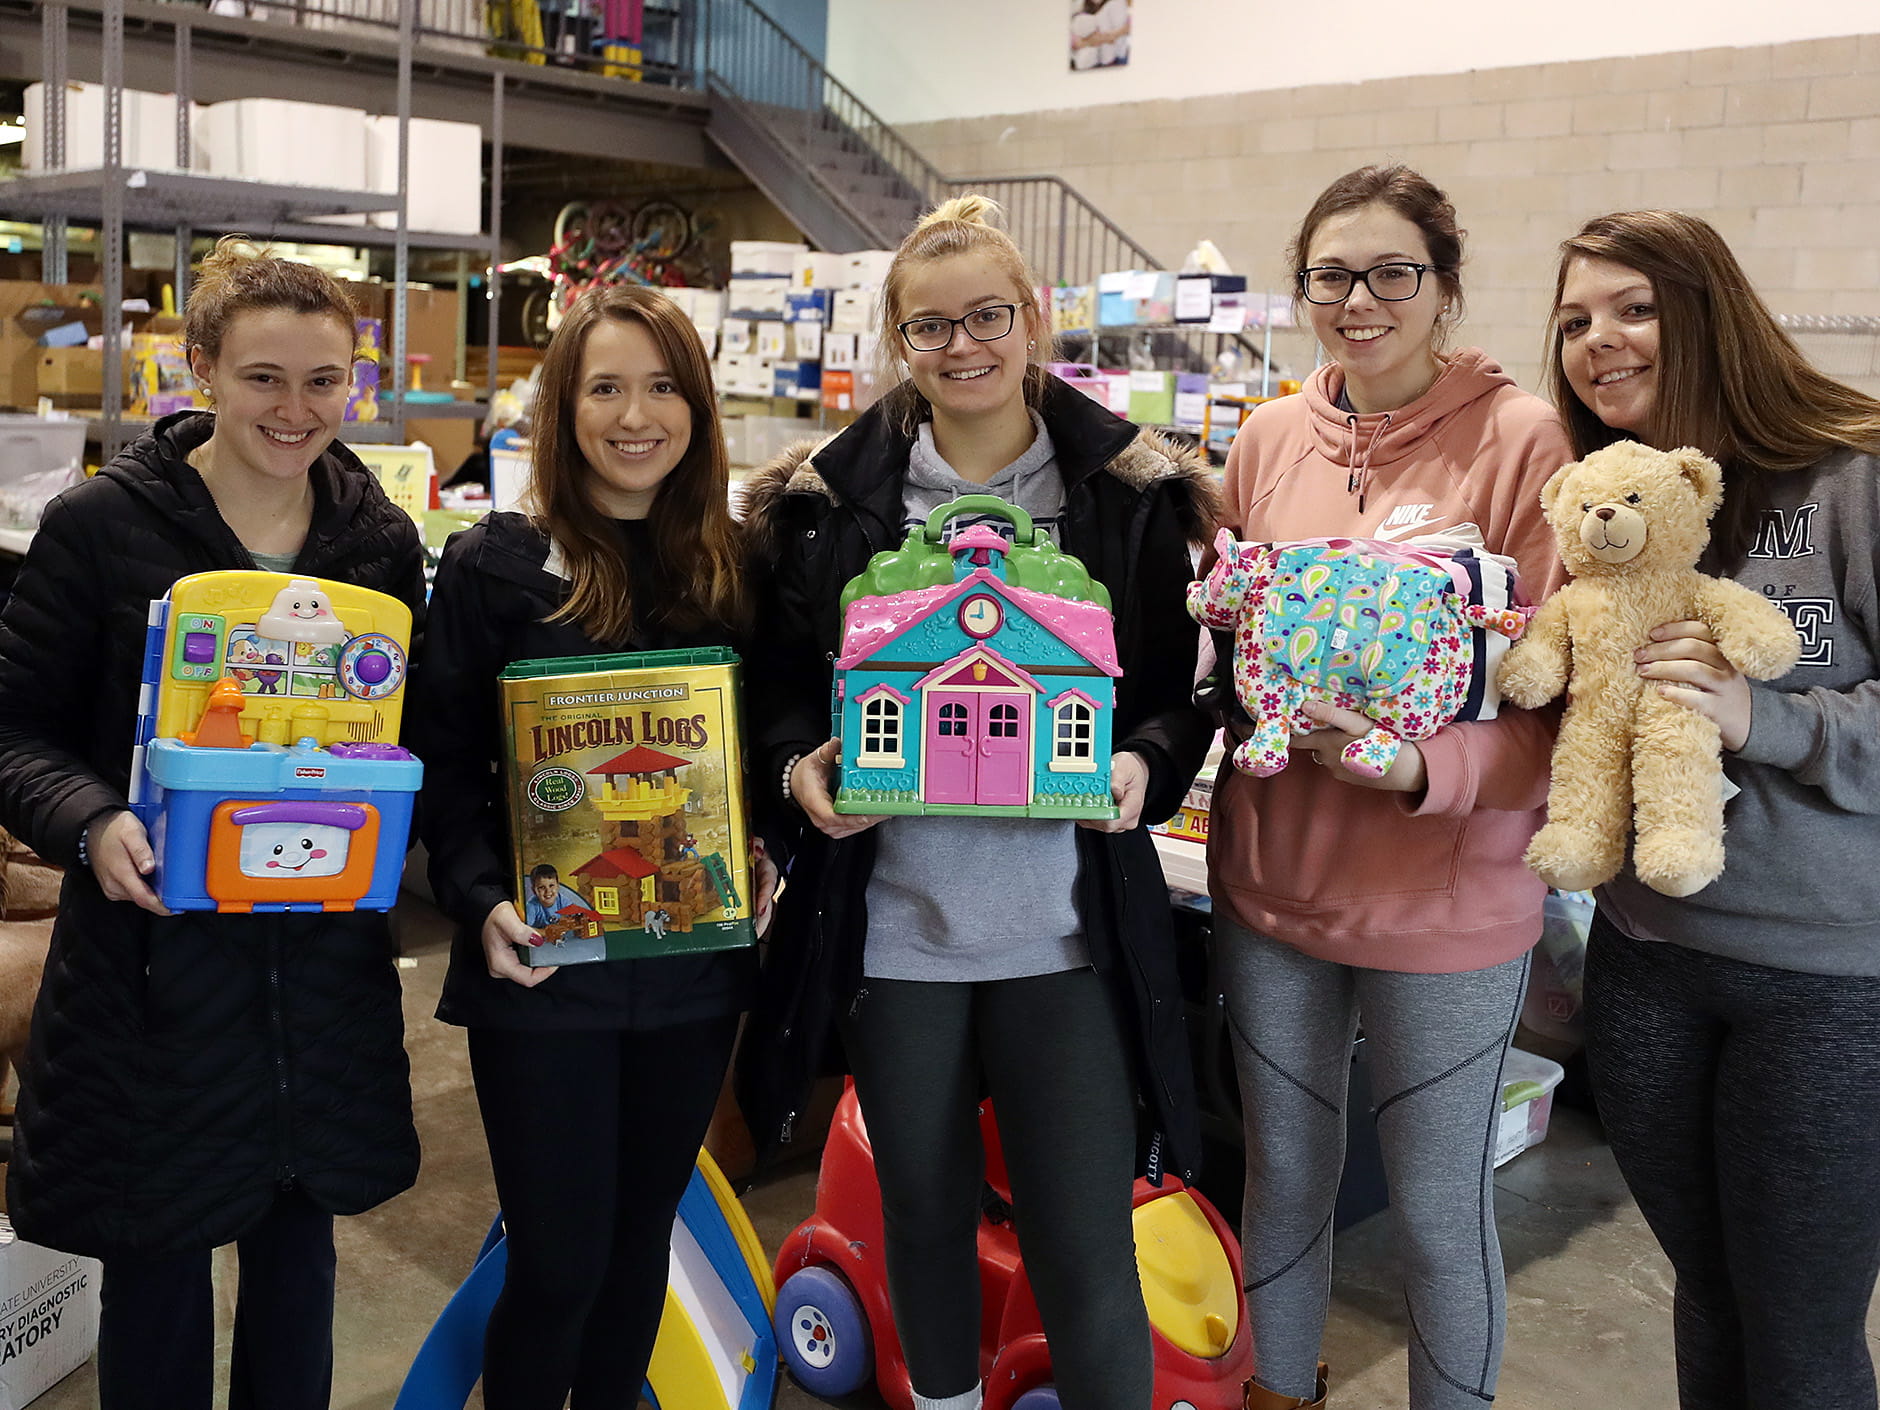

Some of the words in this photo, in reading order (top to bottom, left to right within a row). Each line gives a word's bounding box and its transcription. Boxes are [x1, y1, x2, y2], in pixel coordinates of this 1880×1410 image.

[1385, 504, 1434, 526] NIKE
[1747, 503, 1819, 559] M
[1763, 584, 1796, 596] OF
[191, 618, 215, 630] ON
[1767, 597, 1834, 667] E
[371, 639, 381, 647] 12
[182, 665, 213, 677] OFF
[345, 664, 351, 672] 9
[395, 665, 401, 673] 3
[549, 692, 614, 706] FRONTIER
[613, 687, 684, 702] JUNCTION
[540, 714, 558, 722] THE
[560, 712, 602, 721] ORIGINAL
[530, 715, 634, 767] LINCOLN
[641, 711, 708, 750] LOGS
[545, 777, 564, 786] Real
[544, 784, 567, 794] Wood
[22, 1257, 80, 1301] UNIVERSITY
[18, 1274, 88, 1331] DIAGNOSTIC
[0, 1307, 64, 1367] ATORY
